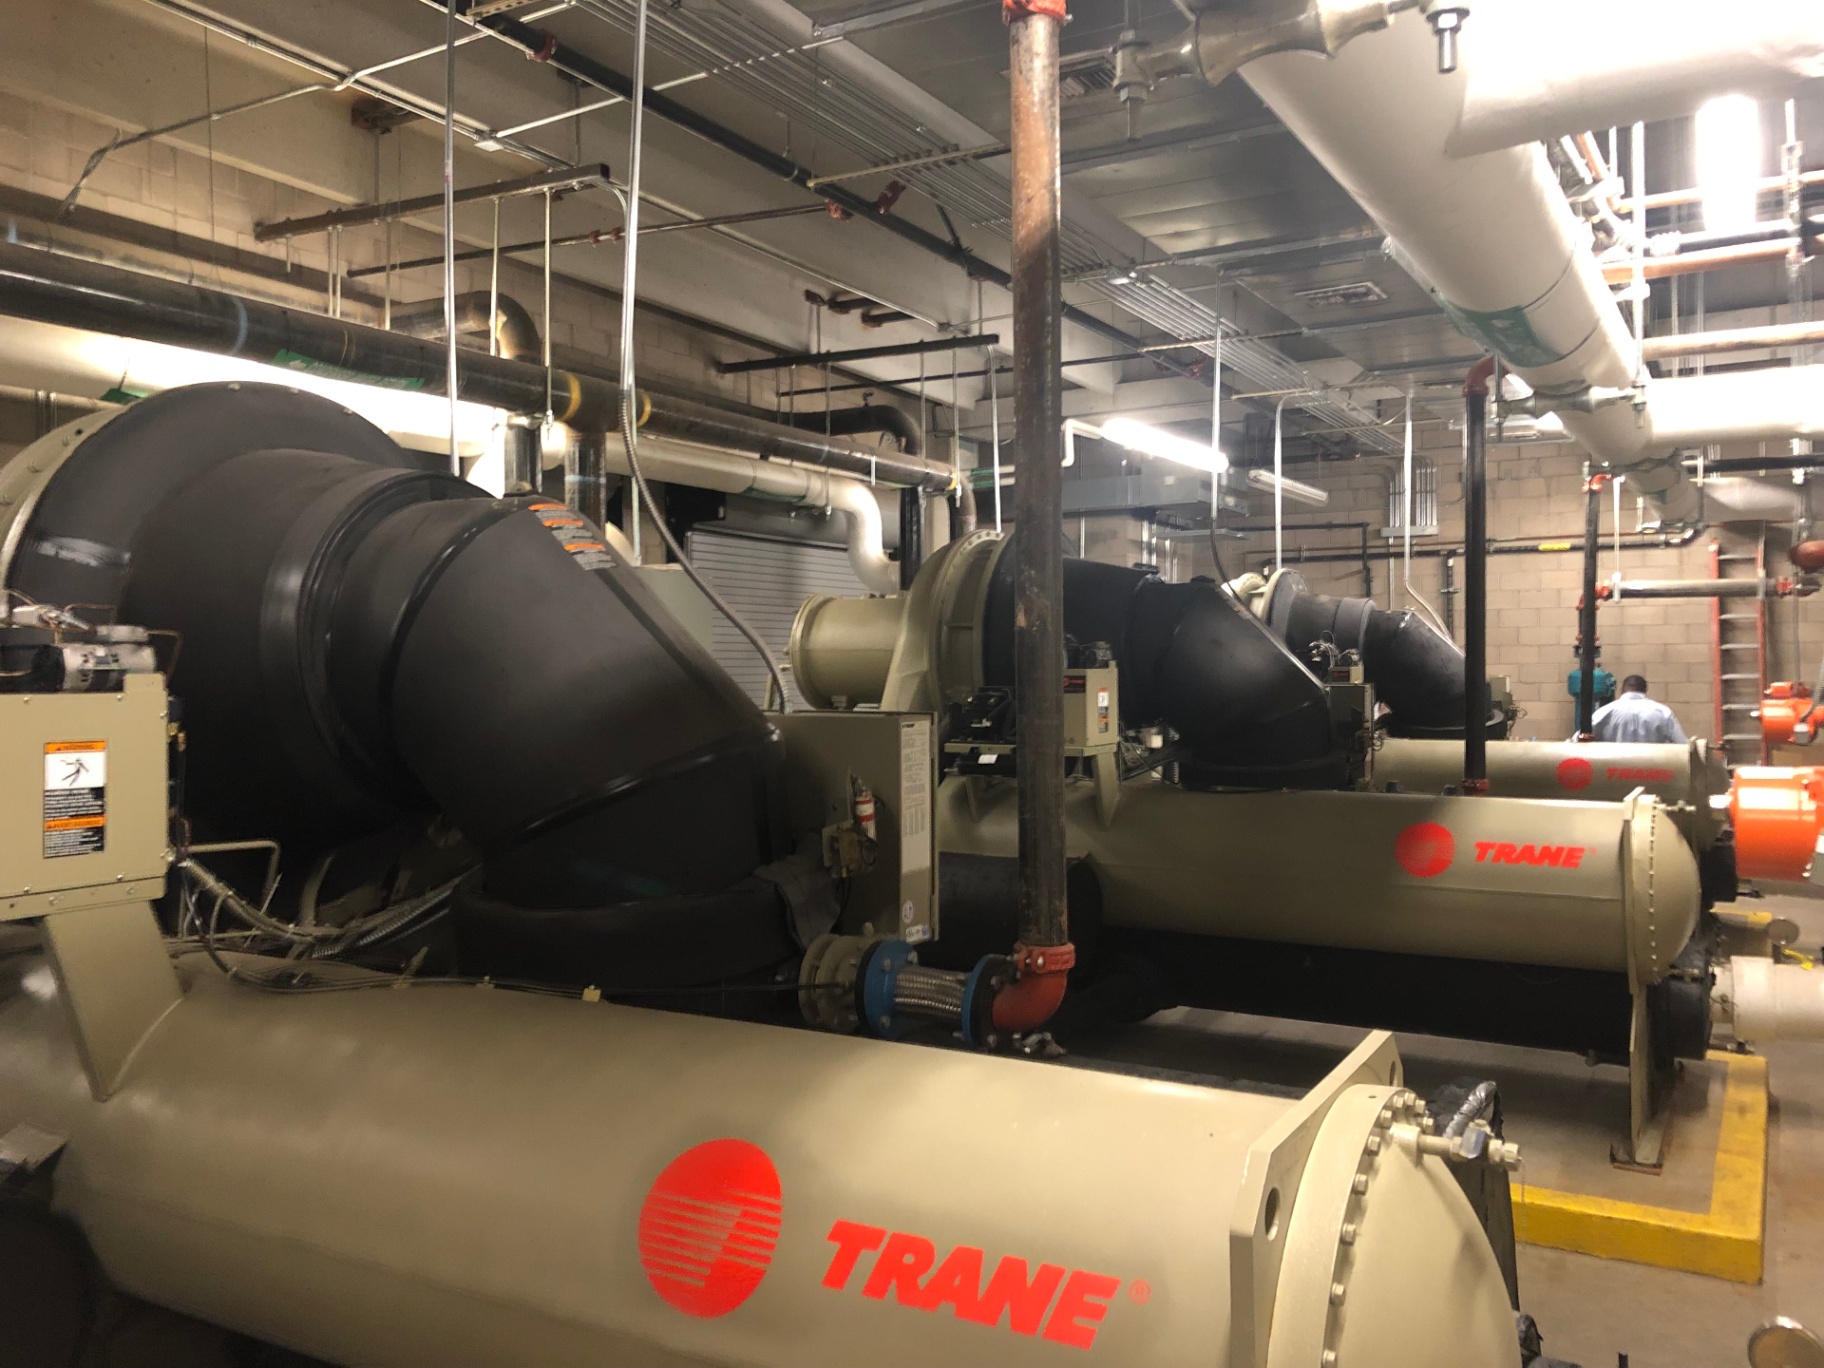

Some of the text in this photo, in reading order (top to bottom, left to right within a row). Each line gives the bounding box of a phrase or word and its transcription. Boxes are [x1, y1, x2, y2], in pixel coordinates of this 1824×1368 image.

[1606, 768, 1674, 782] TRANE
[1474, 841, 1585, 868] TRANE
[821, 1218, 1122, 1352] TRANE
